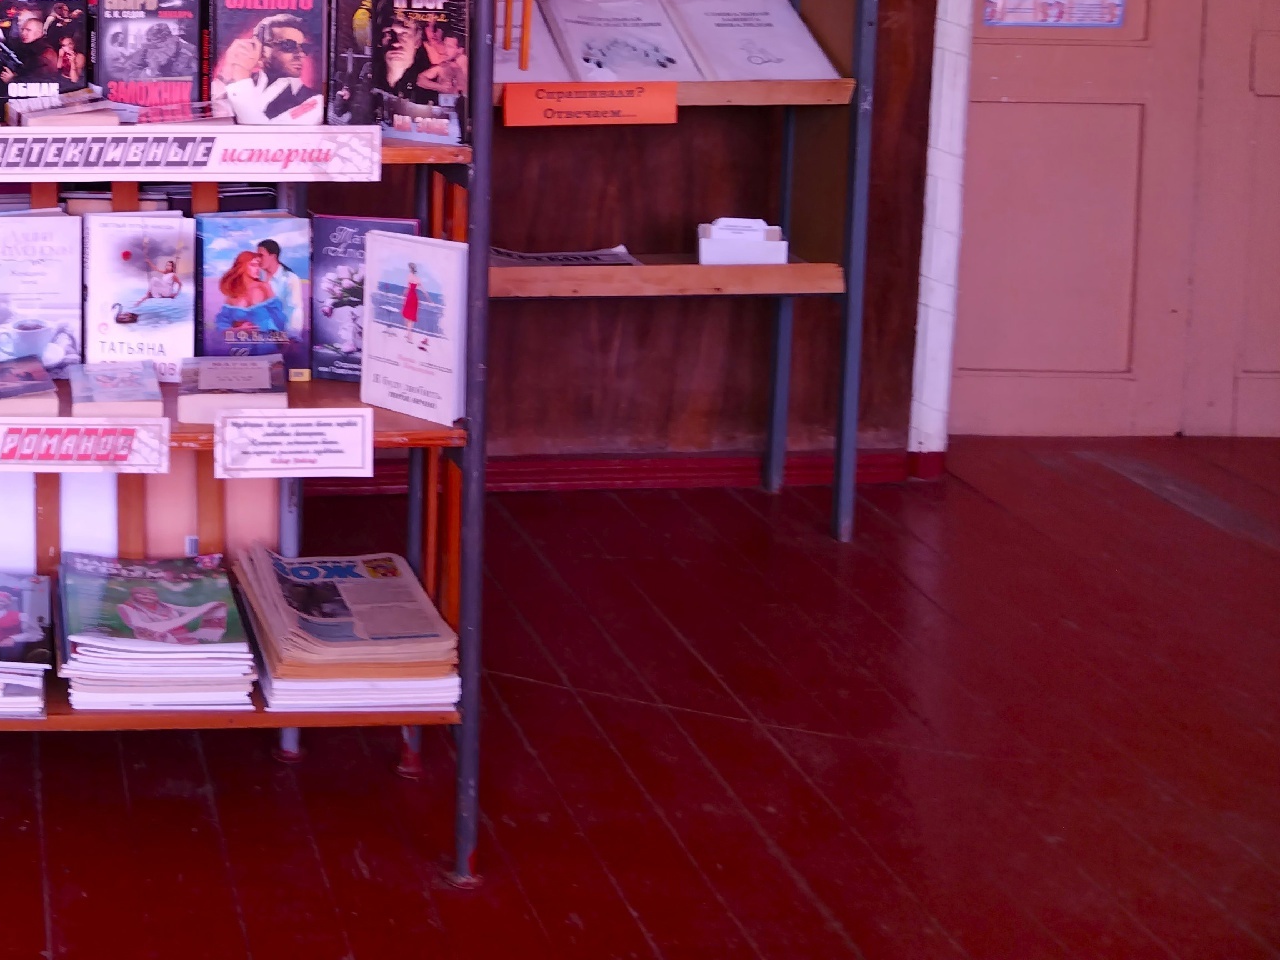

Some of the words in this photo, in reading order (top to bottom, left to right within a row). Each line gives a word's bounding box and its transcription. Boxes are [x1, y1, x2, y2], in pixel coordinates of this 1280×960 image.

[107, 81, 194, 108] ЗАЛОЖНИК
[534, 86, 646, 101] Спрашивали?
[220, 147, 333, 170] истории
[98, 340, 168, 357] ТАТЬЯНА
[0, 428, 135, 460] РОМАНОВ
